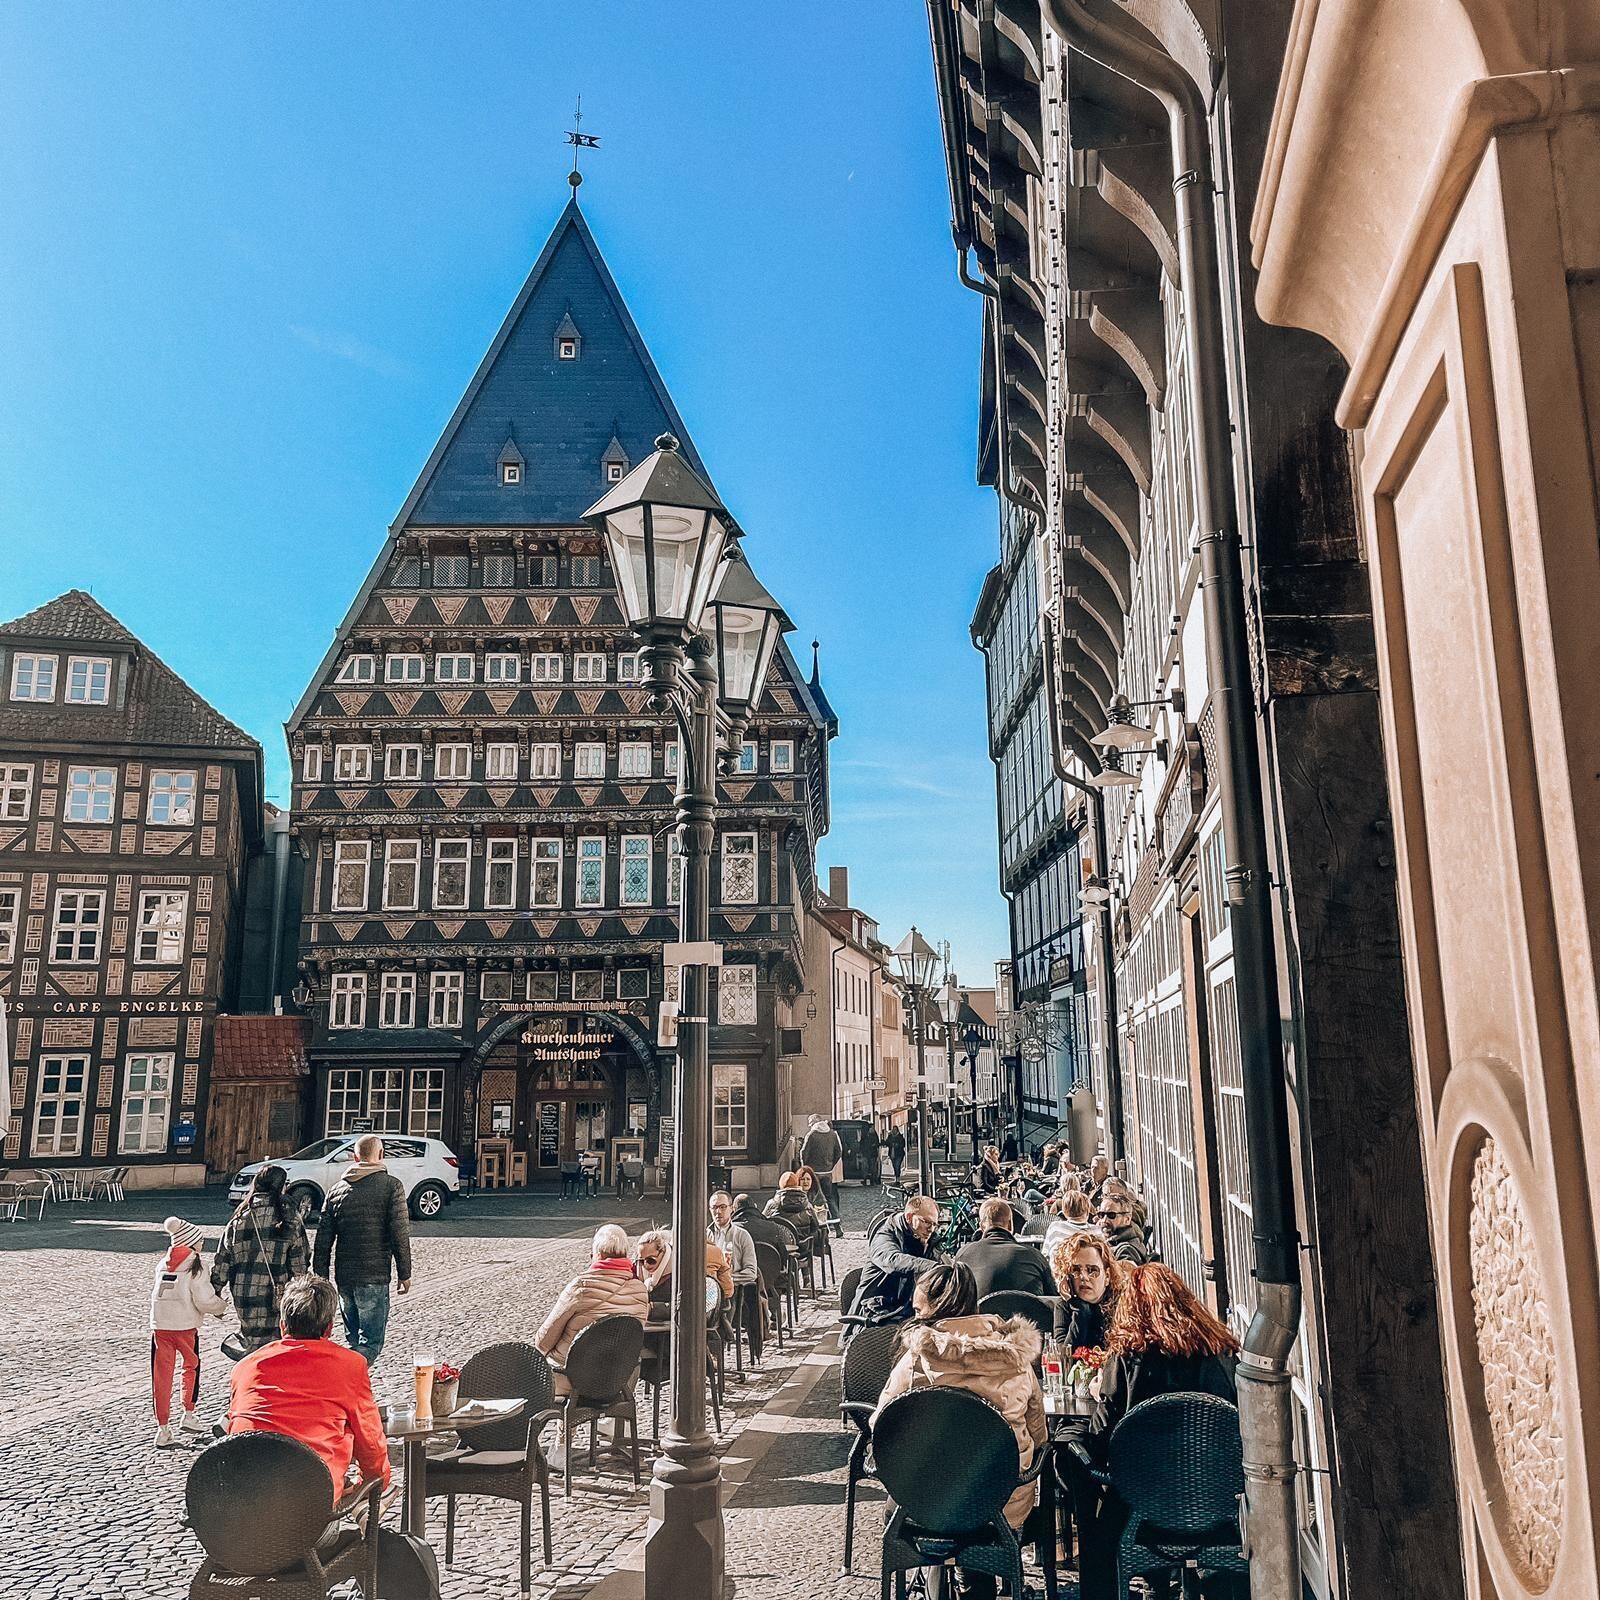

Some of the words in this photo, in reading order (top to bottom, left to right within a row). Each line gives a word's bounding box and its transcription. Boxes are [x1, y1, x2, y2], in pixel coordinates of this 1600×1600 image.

[53, 1002, 101, 1013] CAFE
[119, 1001, 204, 1013] ENGELKE
[521, 1031, 614, 1047] Knochenhauer
[534, 1047, 601, 1063] Amtshaus
